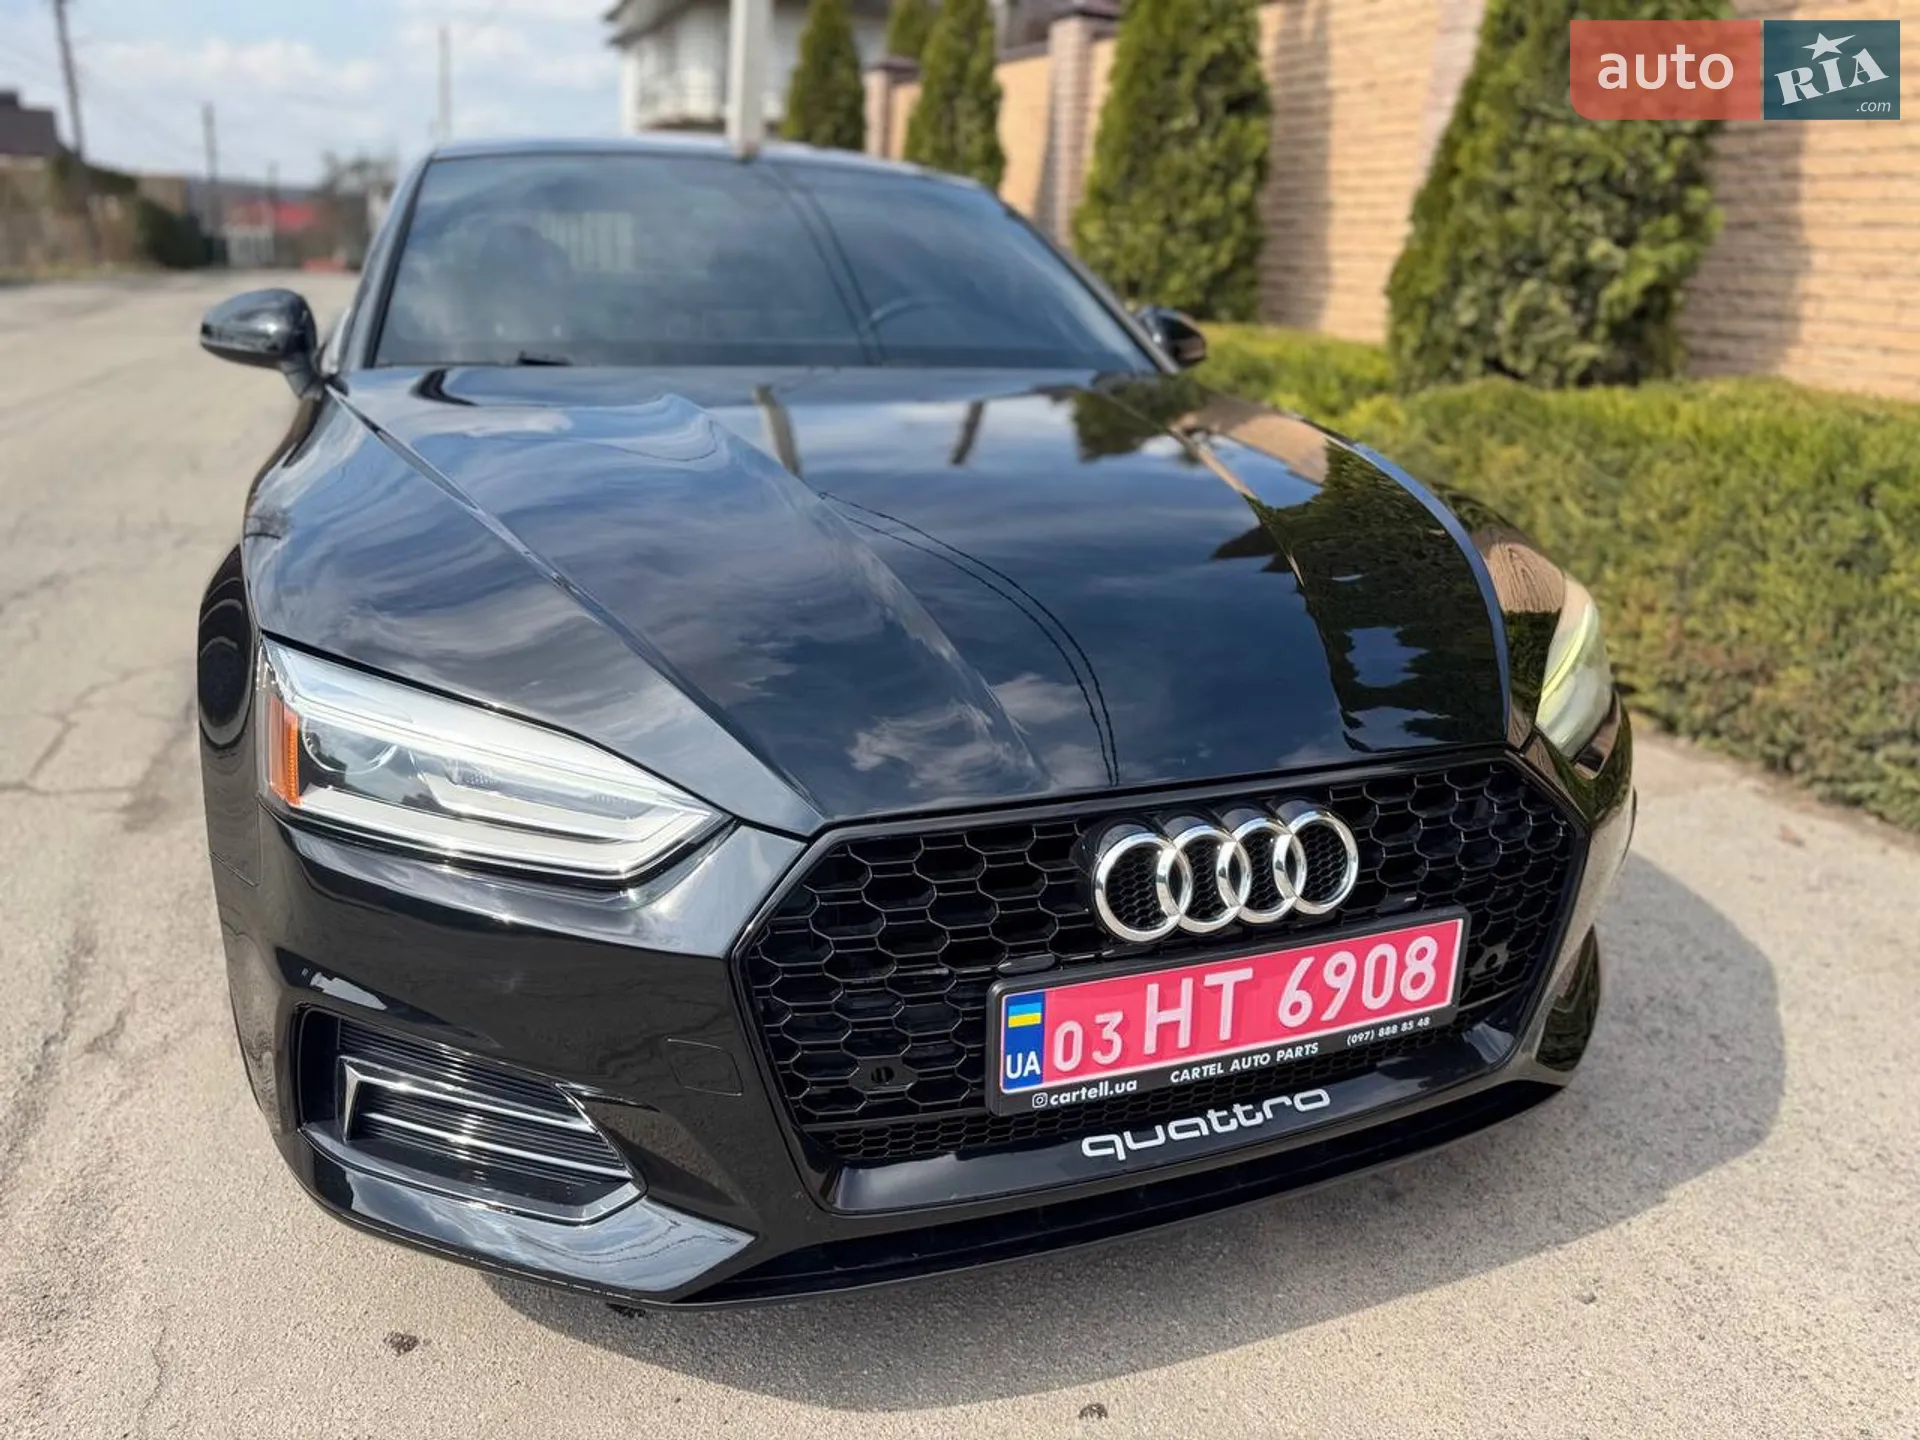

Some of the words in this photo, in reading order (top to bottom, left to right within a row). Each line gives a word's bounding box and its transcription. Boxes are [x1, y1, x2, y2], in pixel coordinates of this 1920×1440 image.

[1053, 1011, 1123, 1072] 03
[1143, 967, 1253, 1055] HT
[1278, 936, 1438, 1028] 6908
[1346, 1029, 1376, 1046] (097)
[1417, 1016, 1430, 1027] 48
[1006, 1051, 1041, 1080] UA
[1170, 1062, 1224, 1084] CARTEL
[1230, 1053, 1271, 1073] AUTO
[1276, 1042, 1319, 1063] PARTS
[1050, 1079, 1138, 1106] cartell.ua
[1081, 1089, 1331, 1161] quattro
